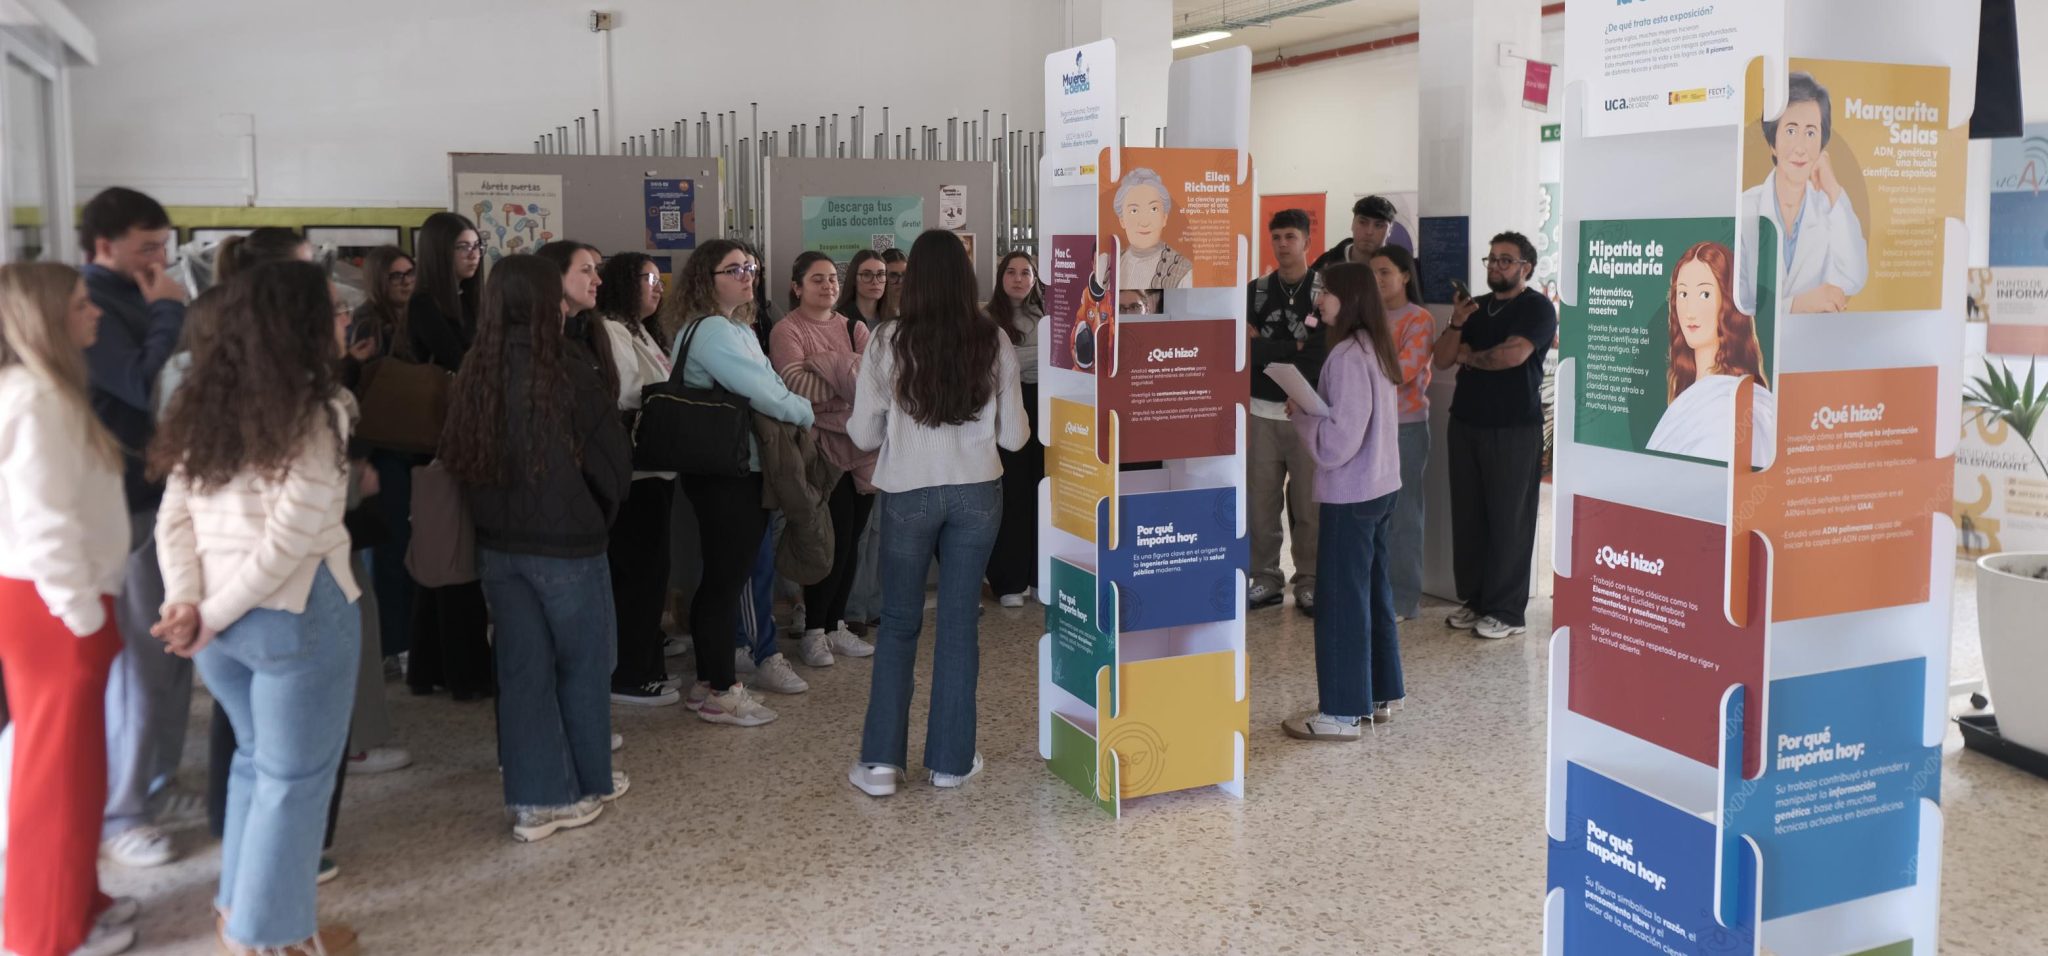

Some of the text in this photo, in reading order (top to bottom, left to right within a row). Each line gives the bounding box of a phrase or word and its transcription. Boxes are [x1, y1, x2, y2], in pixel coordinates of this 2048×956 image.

[1605, 6, 1714, 34] ¿De qué trata esta exposición?
[1605, 98, 1628, 111] uca.
[1845, 97, 1938, 126] Margarita
[1890, 123, 1937, 144] Salas
[1898, 148, 1930, 159] genética
[1932, 150, 1937, 159] y
[1205, 172, 1230, 181] Ellen
[1863, 168, 1936, 179] científica española
[511, 184, 541, 192] puertas
[1185, 182, 1230, 192] Richards
[828, 201, 892, 213] Descarga tus
[822, 215, 894, 230] guías docentes
[1590, 240, 1663, 260] Hipatia de
[1588, 258, 1662, 279] Alejandría
[1589, 287, 1633, 298] Matemática,
[1589, 297, 1633, 309] astrónoma y
[1589, 307, 1617, 315] maestra
[1588, 324, 1608, 332] Hipatia
[1609, 325, 1617, 333] fue
[1631, 326, 1638, 334] de
[1611, 335, 1639, 345] científicas
[1147, 347, 1198, 362] ¿Qué hizo?
[1587, 353, 1615, 361] Alejandría
[1587, 372, 1608, 381] filosofía
[1608, 365, 1644, 374] matemáticas
[1645, 368, 1649, 376] y
[1586, 392, 1617, 401] estudiantes
[1586, 402, 1607, 410] muchos
[1811, 403, 1885, 430] ¿Qué hizo?
[1137, 522, 1173, 536] Por qué
[1137, 533, 1198, 548] importa hoy:
[1140, 559, 1168, 568] ingeniería
[1170, 557, 1198, 565] ambiental
[1595, 545, 1664, 576] ¿Qué hizo?
[1133, 568, 1154, 577] pública
[1593, 585, 1621, 599] Elementos
[1631, 595, 1655, 609] Euclides
[1661, 604, 1685, 617] elaboró
[1615, 582, 1626, 590] con
[1627, 584, 1644, 596] textos
[1645, 589, 1669, 602] clásicos
[1670, 597, 1687, 608] como
[1689, 601, 1698, 611] los
[1592, 596, 1627, 611] comentarios
[1632, 607, 1667, 622] enseñanzas
[1668, 617, 1686, 629] sobre
[1629, 616, 1633, 624] y
[1634, 617, 1669, 634] astronomía.
[1599, 636, 1618, 648] actitud
[1619, 642, 1641, 655] abierta.
[1611, 630, 1622, 639] una
[1623, 634, 1645, 646] escuela
[1646, 642, 1676, 656] respetada
[1698, 658, 1714, 668] rigor
[1777, 726, 1831, 752] Por qué
[1777, 742, 1865, 772] importa hoy:
[1775, 785, 1786, 795] Su
[1788, 781, 1817, 793] trabajo
[1819, 771, 1861, 786] contribuyó
[1870, 762, 1903, 776] entender
[1904, 762, 1910, 771] y
[1775, 780, 1876, 808] manipular la información
[1814, 805, 1832, 814] base
[1834, 799, 1845, 809] de
[1846, 794, 1877, 807] muchas
[1775, 801, 1904, 835] técnicas actuales en biomedicina.
[1587, 819, 1633, 856] Por qué
[1587, 836, 1666, 891] importa hoy:
[1585, 875, 1696, 943] Su figura simboliza la razón, el
[1585, 890, 1664, 938] pensamiento libre y el
[1585, 901, 1662, 949] valor de la educación
